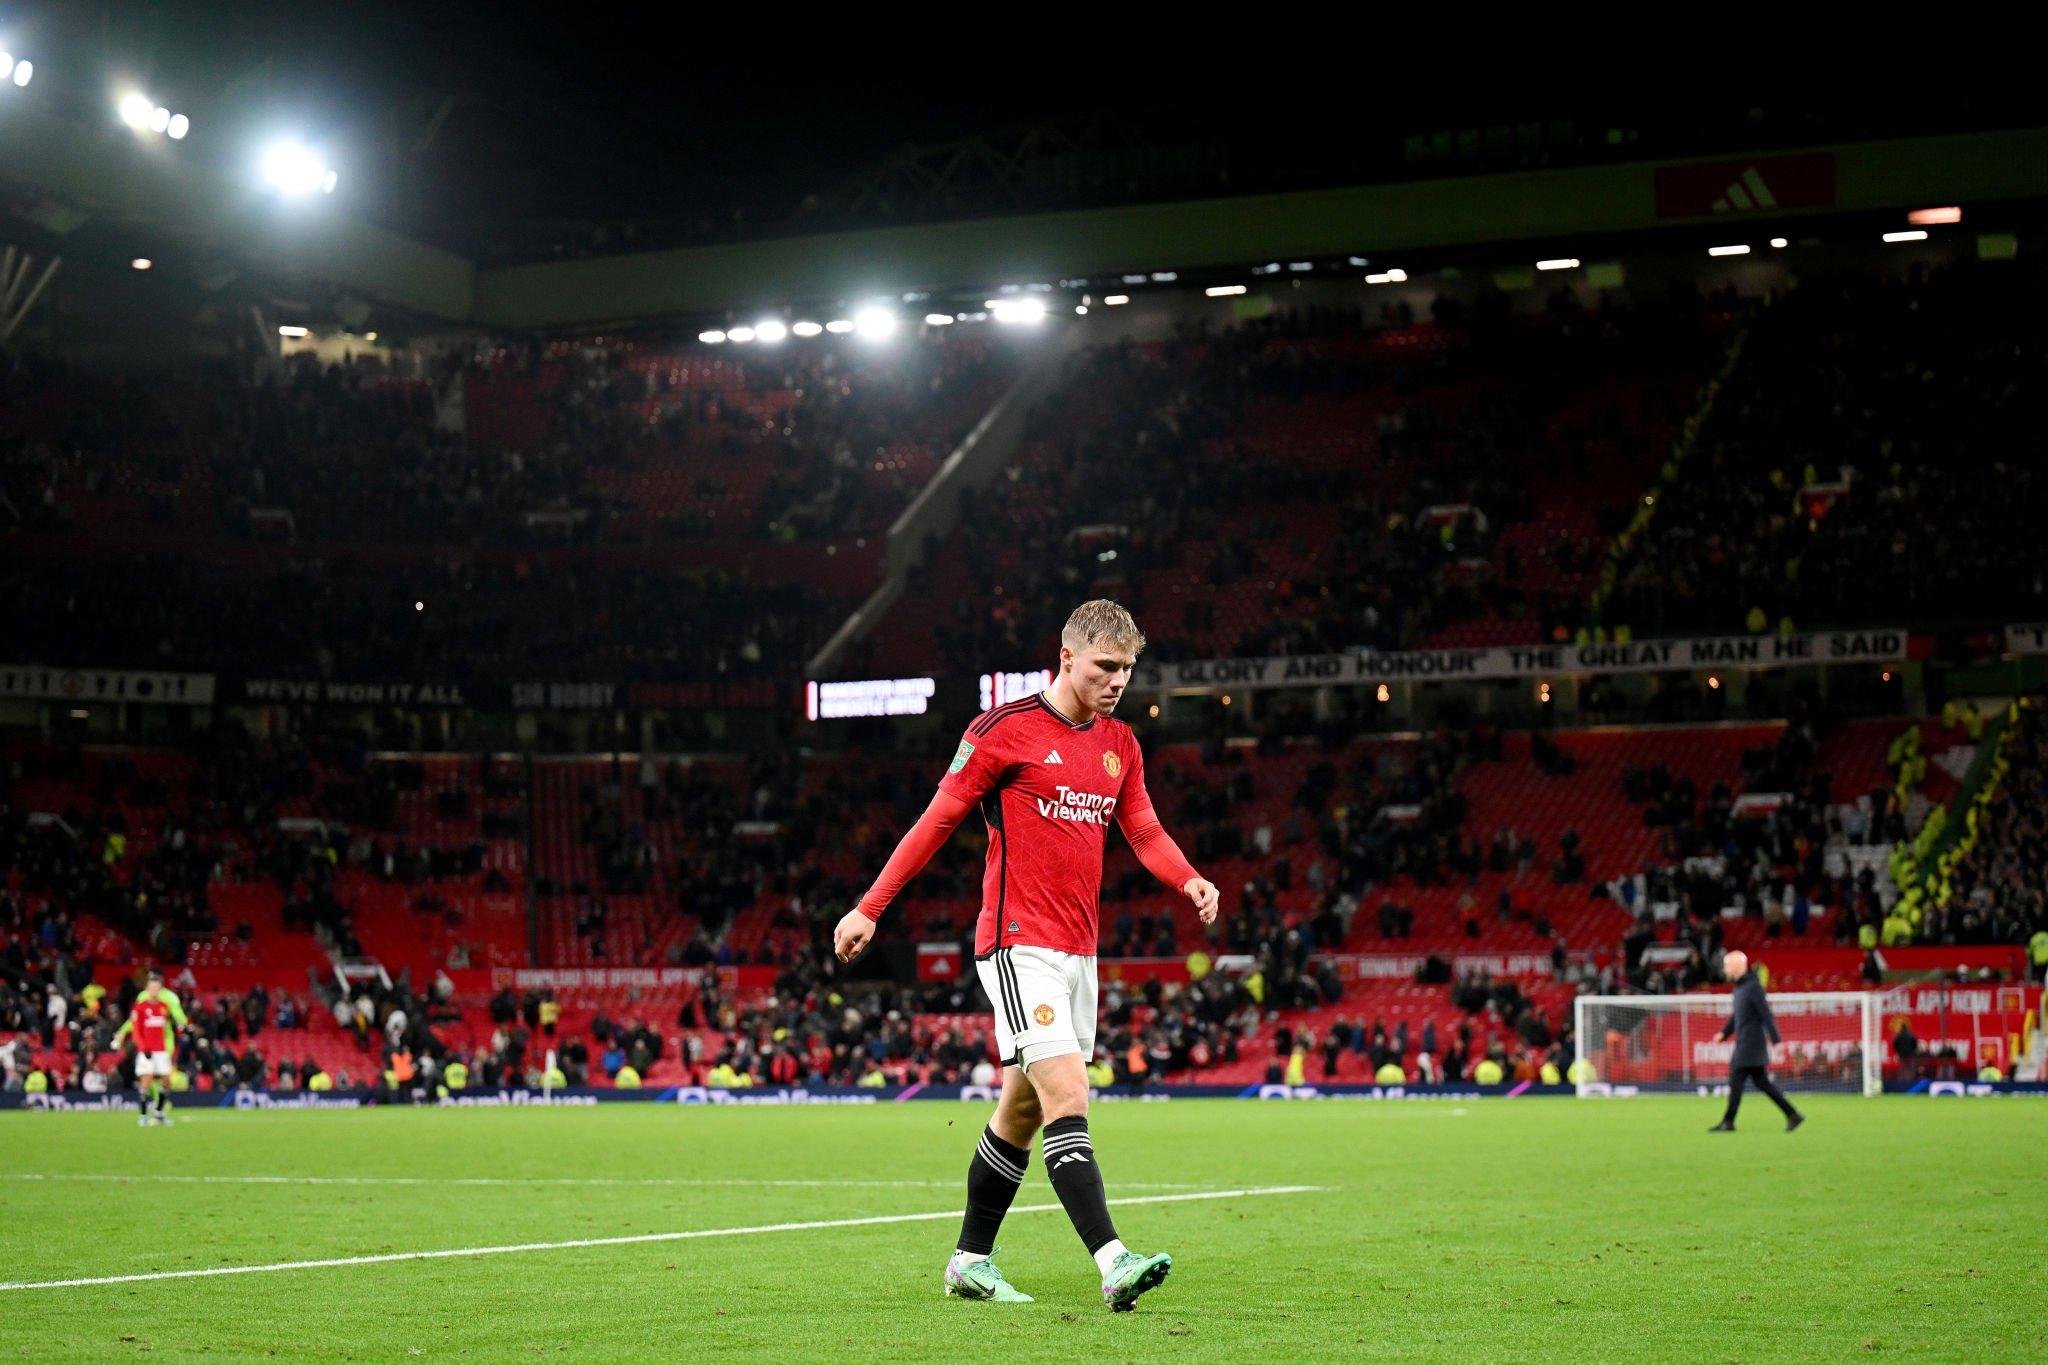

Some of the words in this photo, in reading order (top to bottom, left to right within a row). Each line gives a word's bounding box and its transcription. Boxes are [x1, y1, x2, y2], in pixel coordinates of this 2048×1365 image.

[1177, 661, 1265, 685] GLORY
[1284, 656, 1342, 680] AND
[1512, 647, 1560, 670] THE
[1579, 640, 1673, 667] GREAT
[1692, 637, 1758, 662] MAN
[1774, 635, 1811, 657] HE
[1830, 632, 1899, 656] SAID
[327, 682, 384, 703] WON
[389, 683, 414, 703] IT
[419, 683, 464, 704] ALL
[1055, 785, 1103, 809] Team
[1037, 797, 1098, 824] Viewer
[1916, 990, 1949, 1013] APP
[1952, 990, 1990, 1012] NOW
